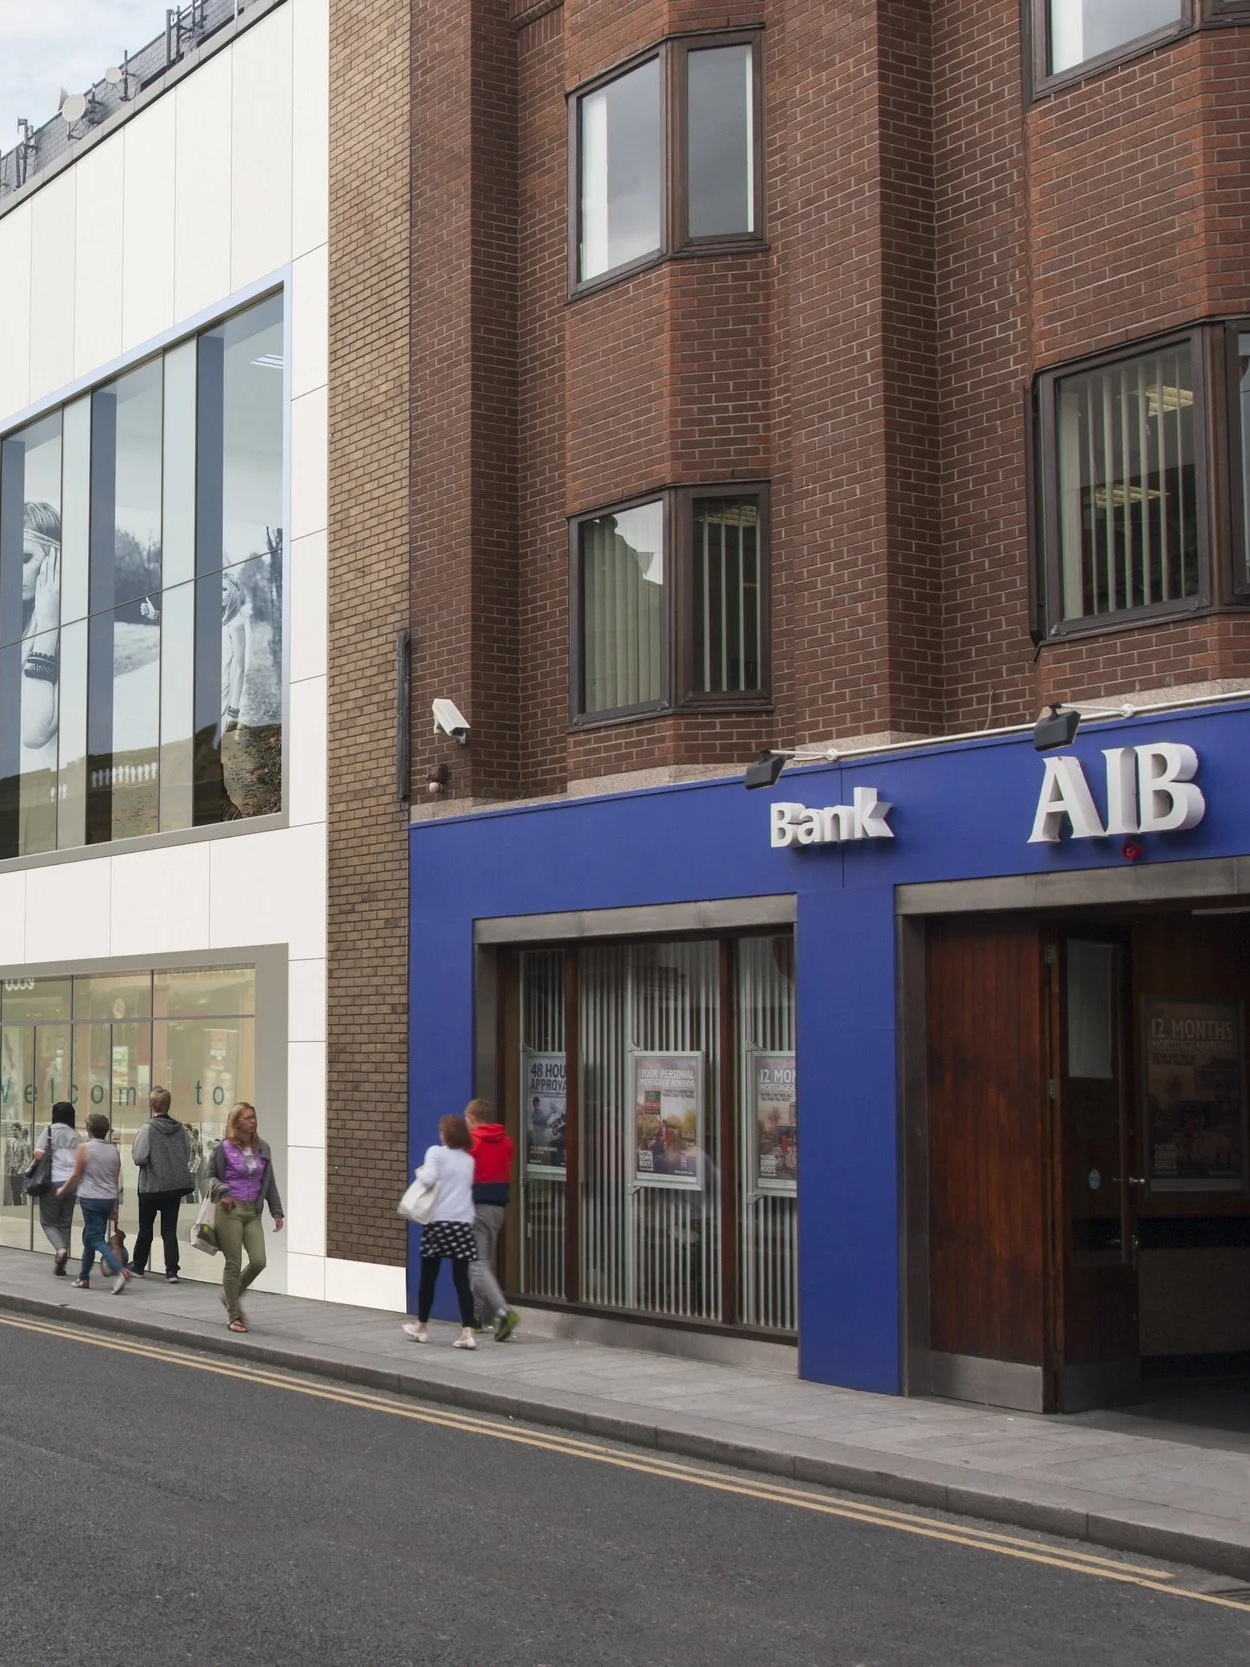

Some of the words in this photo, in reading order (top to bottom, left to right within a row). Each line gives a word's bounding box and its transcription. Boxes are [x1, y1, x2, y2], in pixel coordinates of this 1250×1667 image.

[1027, 742, 1205, 844] AIB
[770, 787, 894, 848] Bank
[1151, 1018, 1164, 1037] 12
[1172, 1019, 1233, 1040] MONTHS
[530, 1063, 543, 1077] 48
[545, 1063, 566, 1079] HOU
[760, 1068, 770, 1083] 12
[195, 1080, 225, 1106] to
